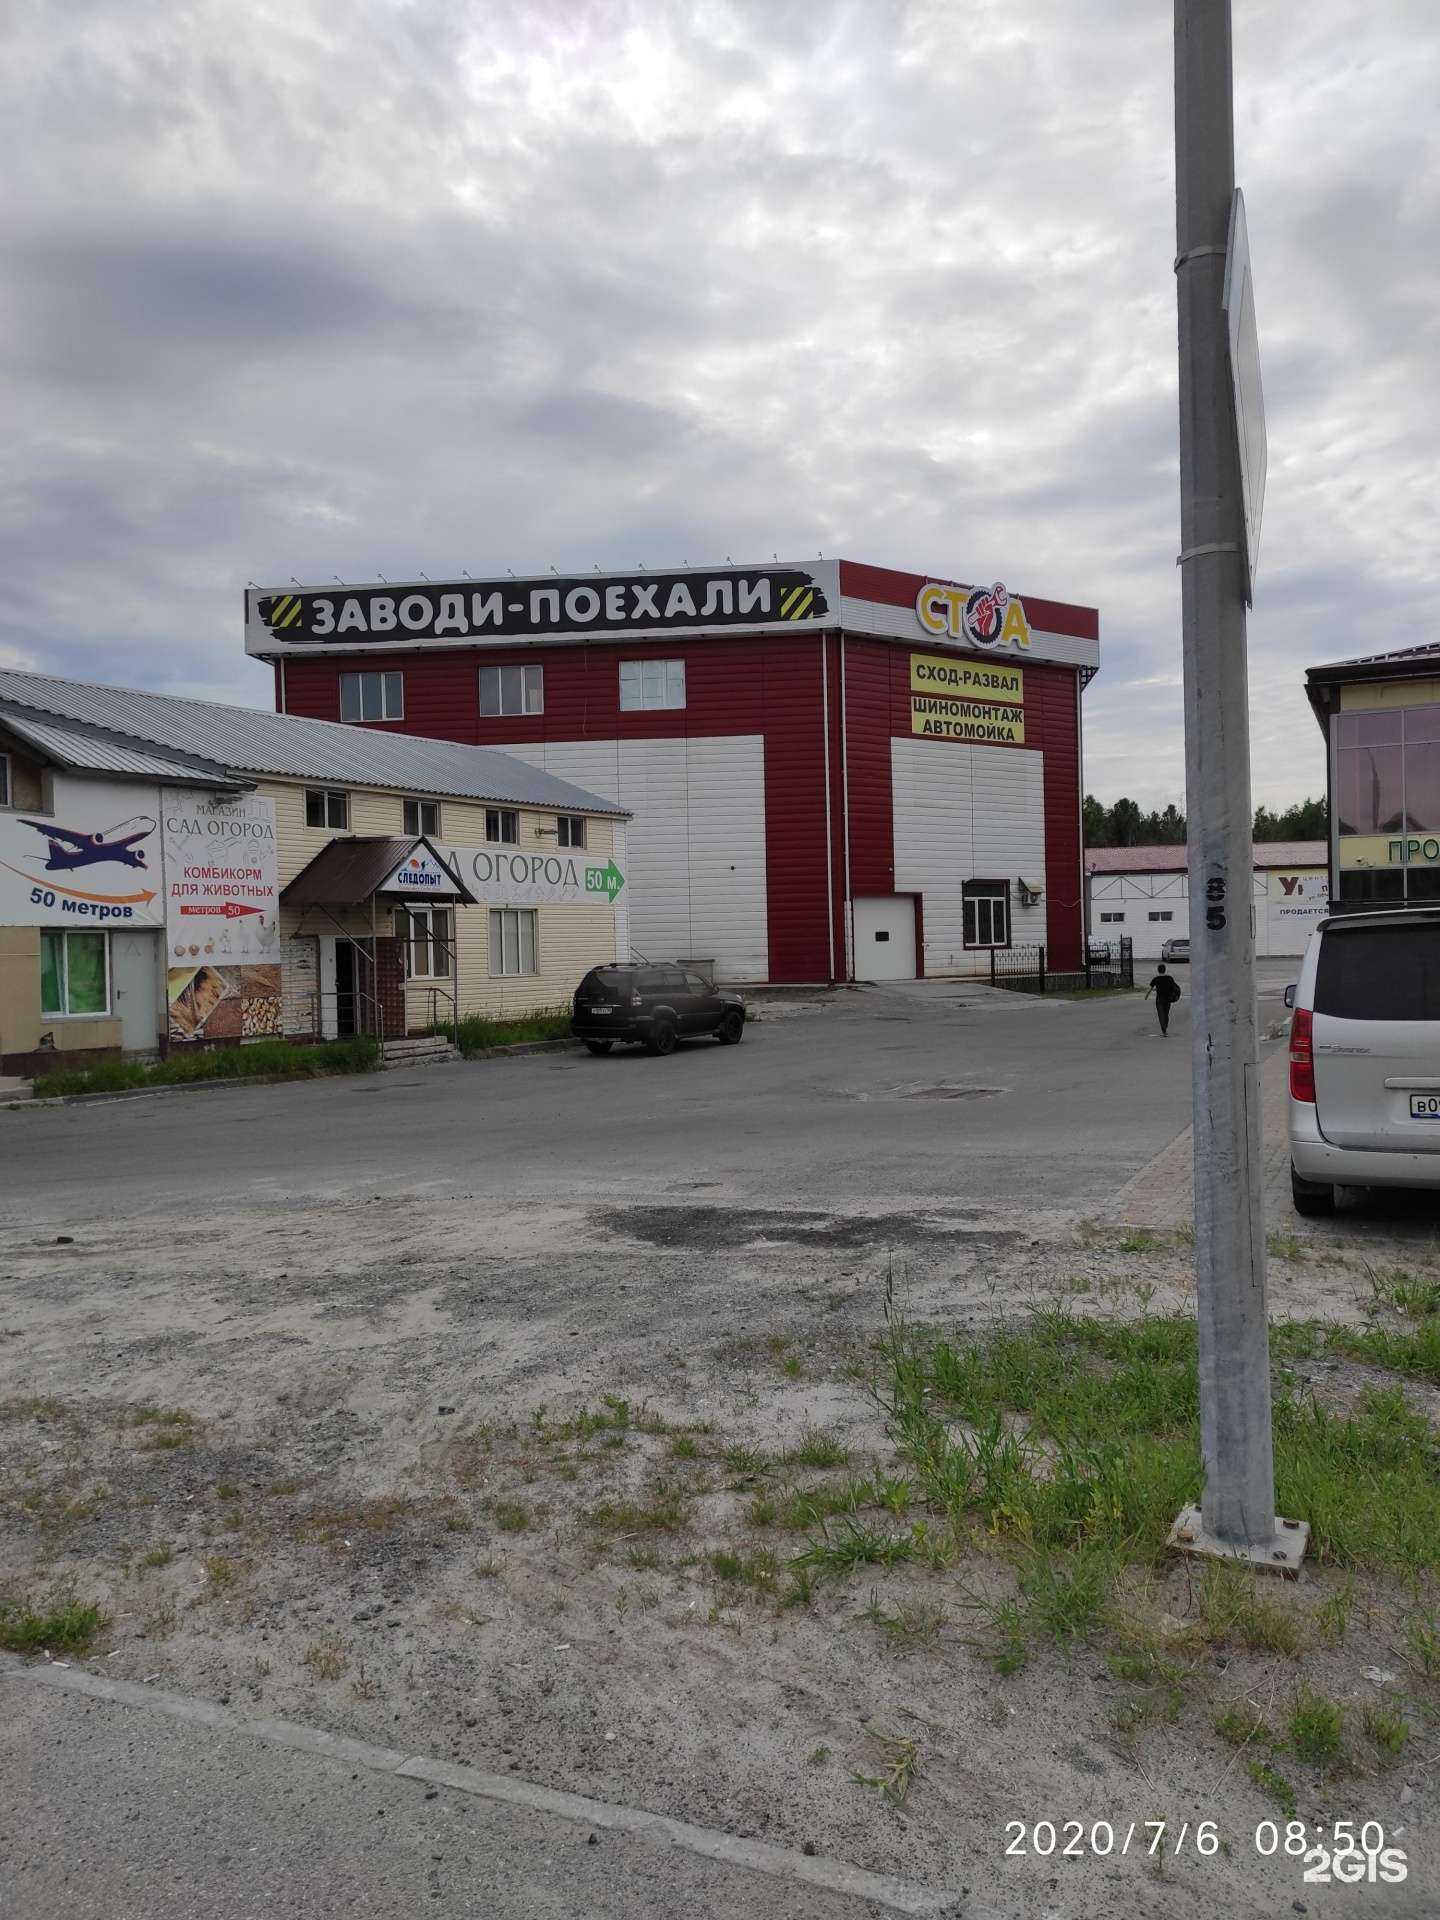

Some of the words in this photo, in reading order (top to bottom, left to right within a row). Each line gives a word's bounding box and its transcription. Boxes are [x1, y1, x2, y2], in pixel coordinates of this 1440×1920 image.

[312, 578, 772, 636] ЗАВОДИ-ПОЕХАЛИ
[916, 664, 1020, 692] СХОД-РАЗВАЛ
[913, 697, 1024, 724] ШИНОМОНТАЖ
[923, 719, 1016, 742] АВТОМОЙКА
[196, 804, 246, 818] МАГАЗИН
[166, 818, 202, 836] САД
[207, 820, 276, 840] ОГОРОД
[184, 866, 262, 881] КОМБИКОРМ
[397, 872, 442, 886] СЛЕДОПЫТ
[472, 852, 580, 888] ОГОРОД
[171, 883, 199, 898] ДЛЯ
[203, 884, 274, 898] ЖИВОТНЫХ
[586, 871, 602, 891] 50
[30, 887, 56, 908] 50
[61, 898, 134, 921] метров
[188, 905, 221, 917] метров
[227, 904, 241, 916] 50
[1417, 1098, 1440, 1113] В0
